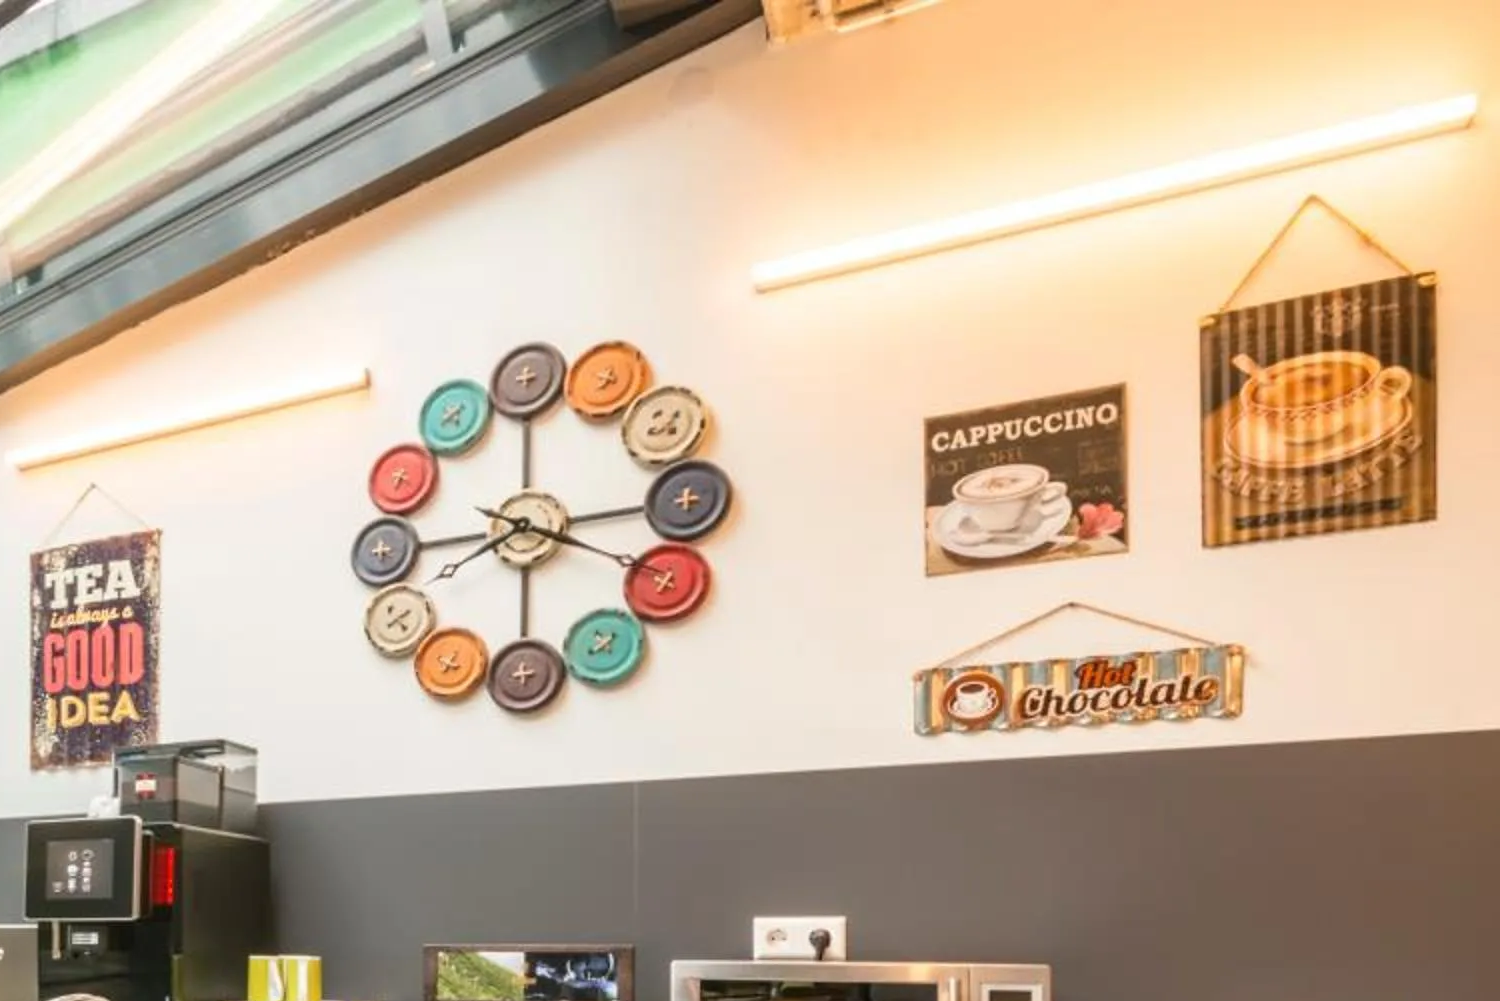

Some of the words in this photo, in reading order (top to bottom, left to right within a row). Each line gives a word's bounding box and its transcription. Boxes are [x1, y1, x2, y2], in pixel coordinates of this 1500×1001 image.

[931, 403, 1118, 453] CAPPUCCINO
[44, 559, 141, 609] TEA
[43, 621, 145, 694] GOOD
[1074, 658, 1137, 690] Hot
[47, 690, 141, 730] IDEA
[1019, 674, 1220, 721] Chocolate
